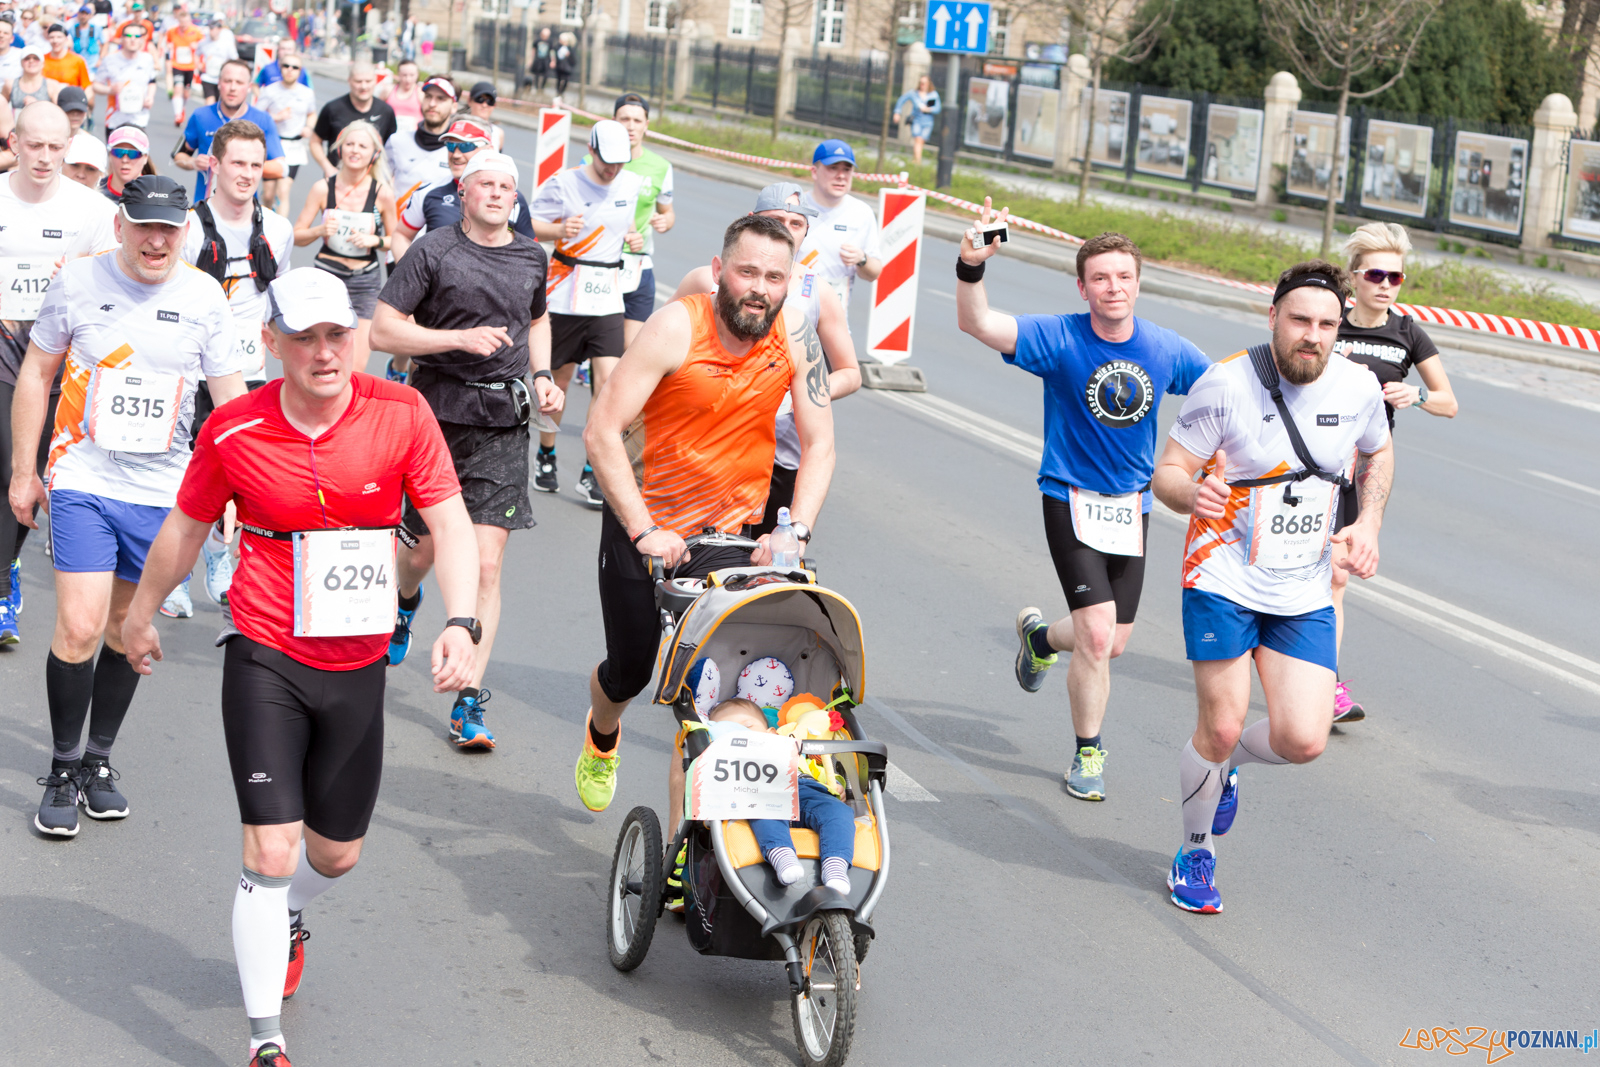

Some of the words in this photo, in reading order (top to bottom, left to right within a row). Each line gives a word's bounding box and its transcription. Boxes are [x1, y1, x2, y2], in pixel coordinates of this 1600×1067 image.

[11, 278, 50, 293] 4112
[1094, 362, 1153, 401] NIESPOKOJNYCH
[111, 395, 165, 419] 8315
[1086, 383, 1104, 419] ZESPÓŁ
[1132, 404, 1150, 422] NÓG
[1085, 503, 1133, 526] 11583
[1270, 513, 1324, 535] 8685
[323, 564, 388, 591] 6294
[804, 743, 826, 752] Jeep
[713, 758, 779, 785] 5109
